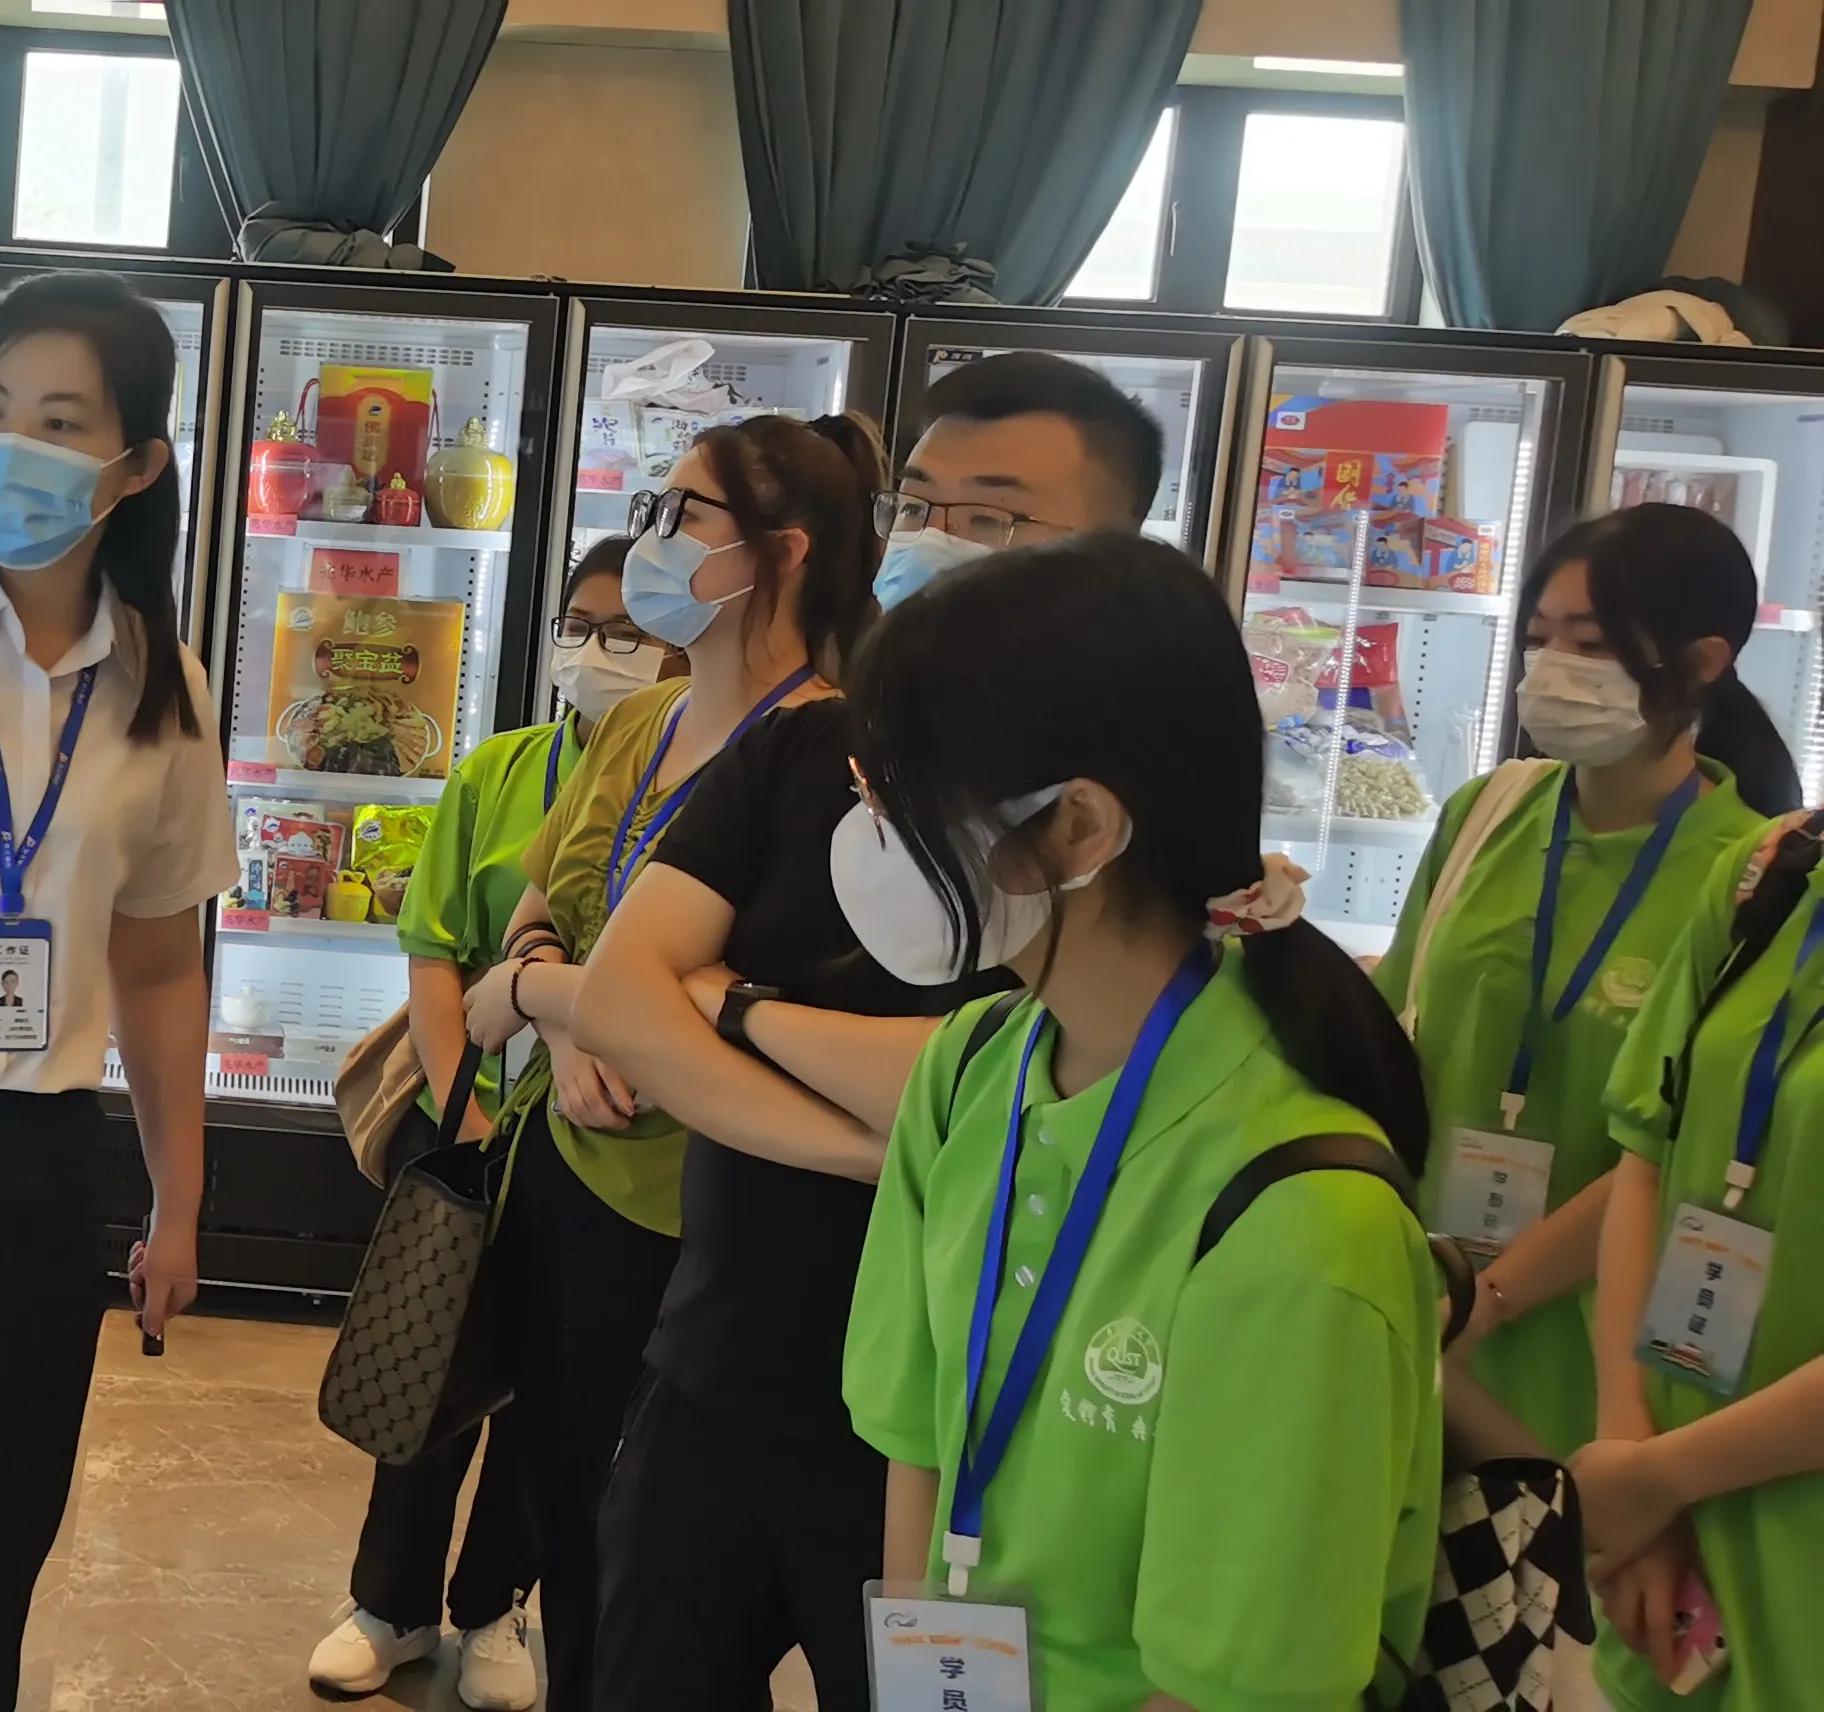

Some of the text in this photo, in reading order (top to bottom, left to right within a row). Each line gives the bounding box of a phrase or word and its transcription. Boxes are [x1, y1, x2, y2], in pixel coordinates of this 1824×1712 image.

[342, 610, 397, 637] 鲍参
[331, 649, 403, 674] 聚宝盆
[939, 1656, 968, 1712] 学员
